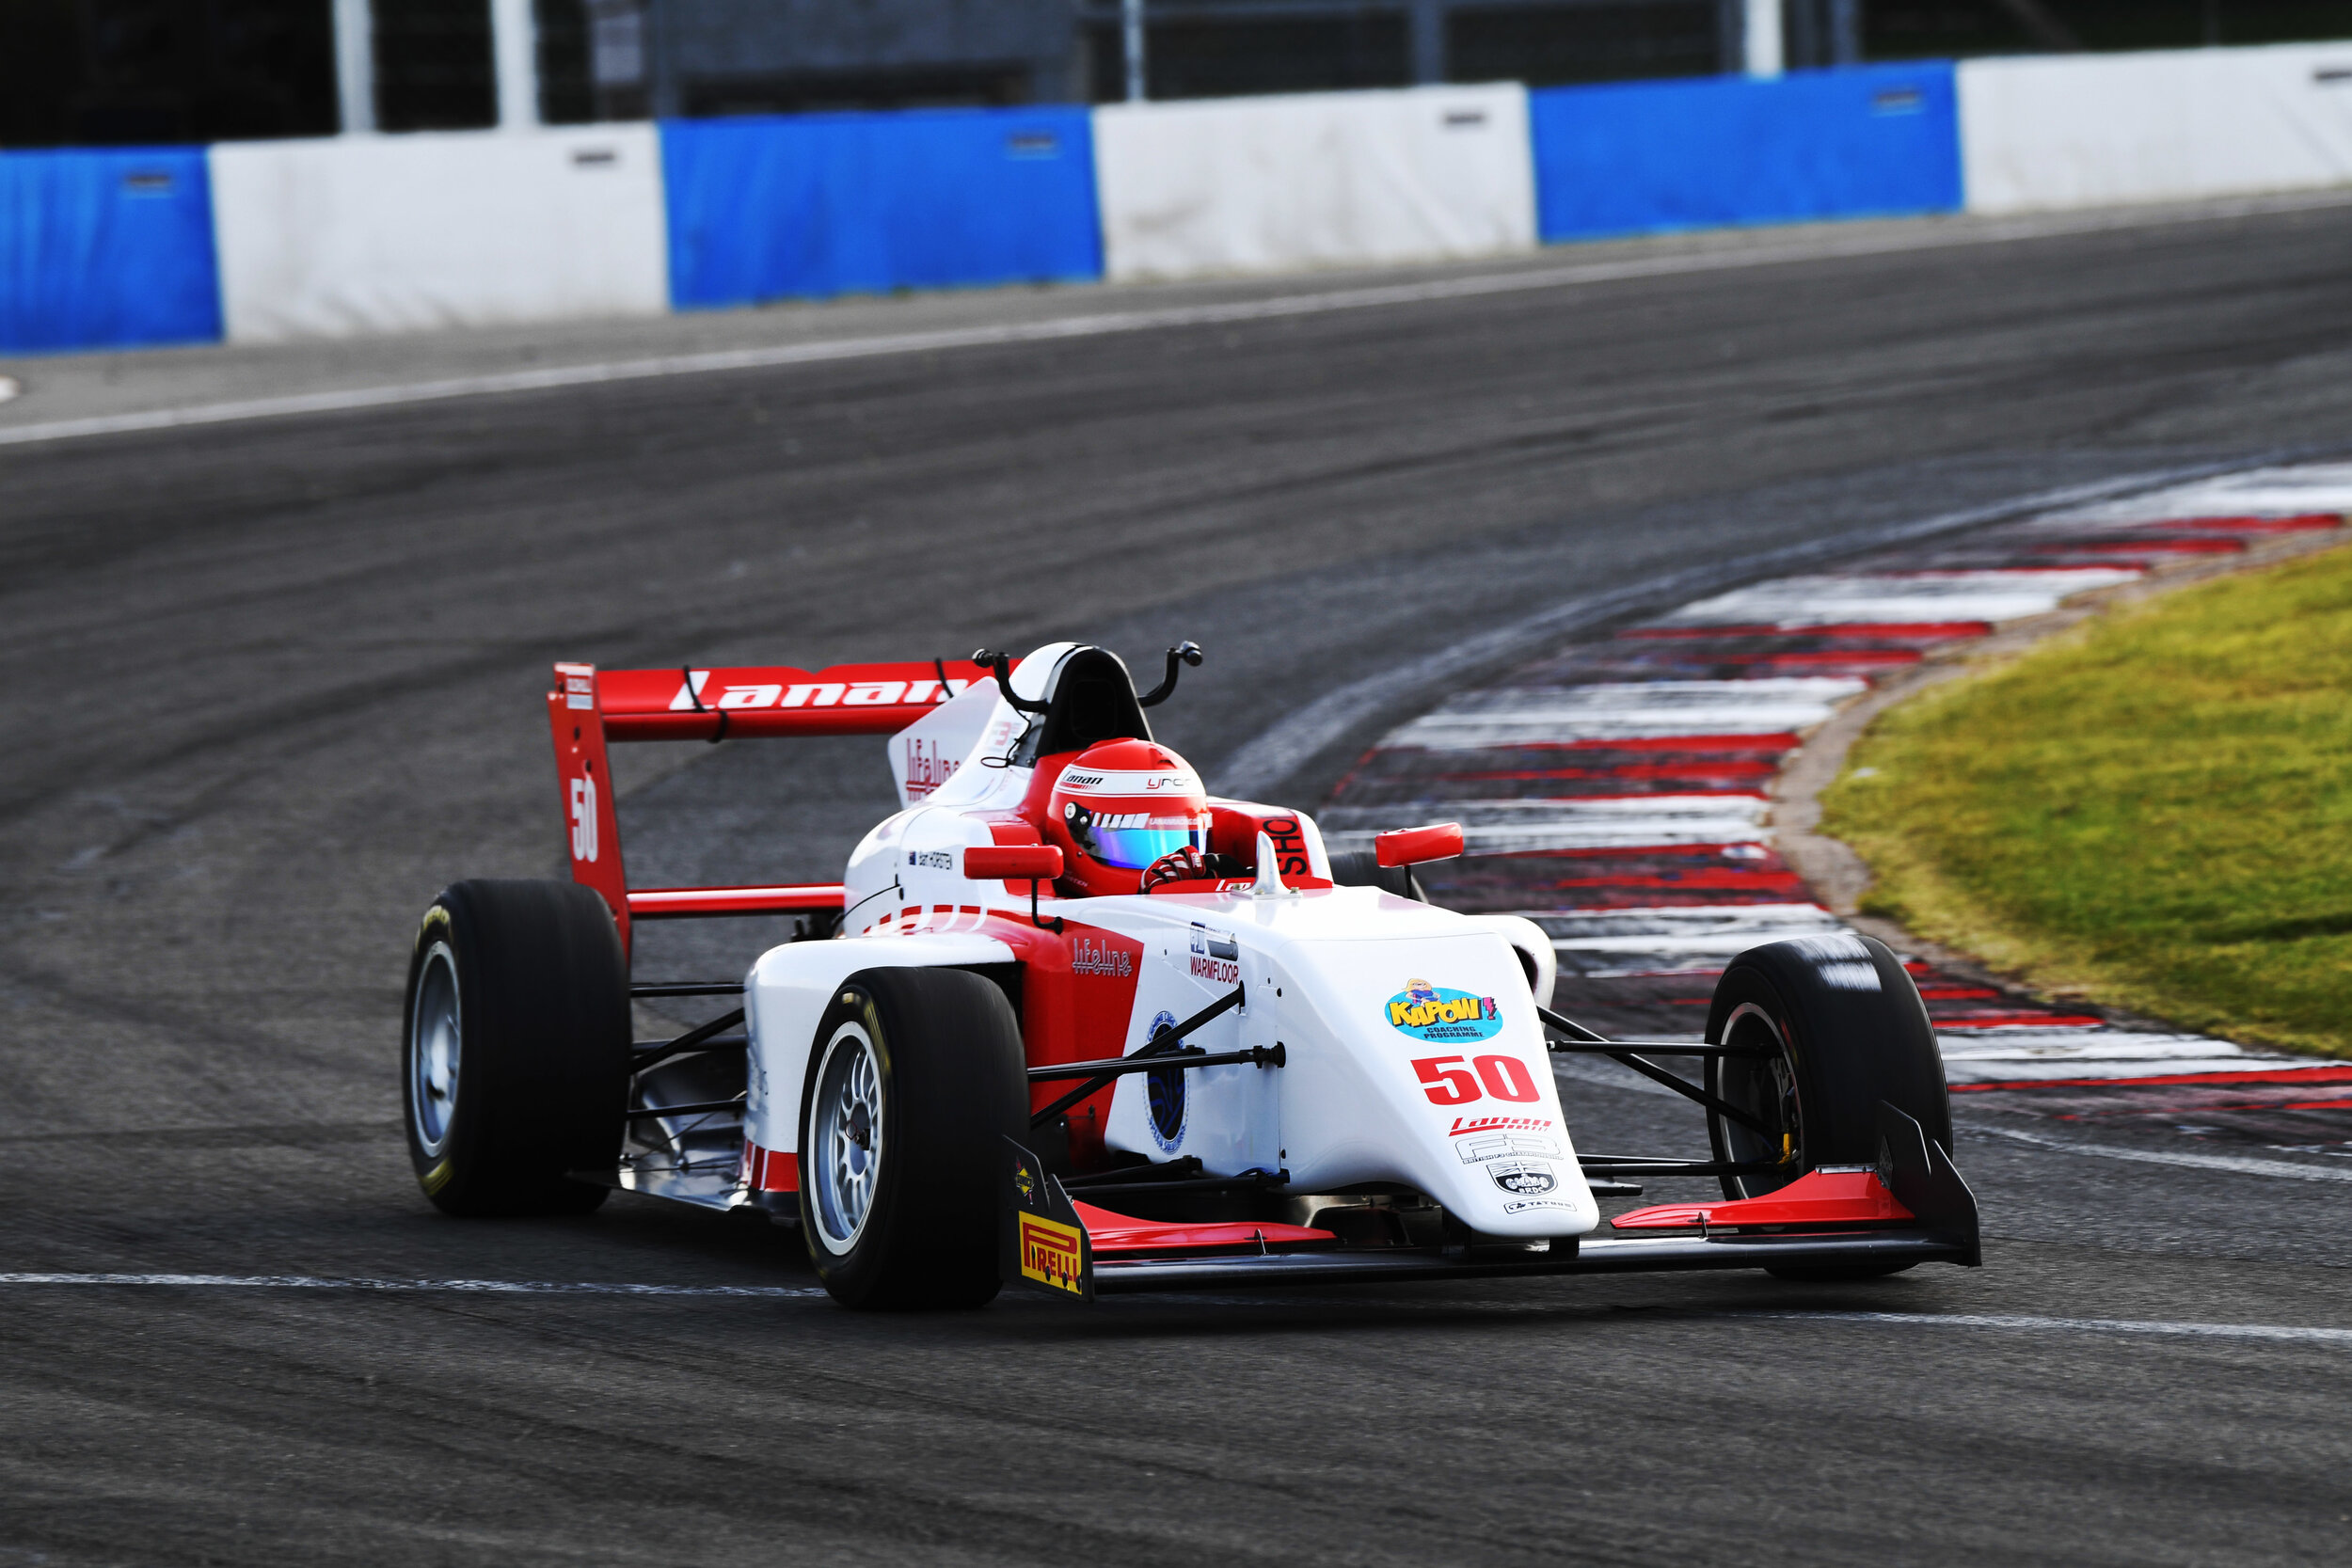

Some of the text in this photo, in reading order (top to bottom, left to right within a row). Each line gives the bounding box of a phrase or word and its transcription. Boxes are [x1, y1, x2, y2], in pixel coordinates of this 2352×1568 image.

[669, 671, 968, 709] Lanan
[571, 777, 598, 863] 50
[1190, 955, 1240, 986] WARMFLOOR
[1426, 1025, 1477, 1034] COACHING
[1410, 1054, 1541, 1106] 50
[1518, 1186, 1545, 1195] BRDC
[1023, 1221, 1078, 1283] PIRELLI
